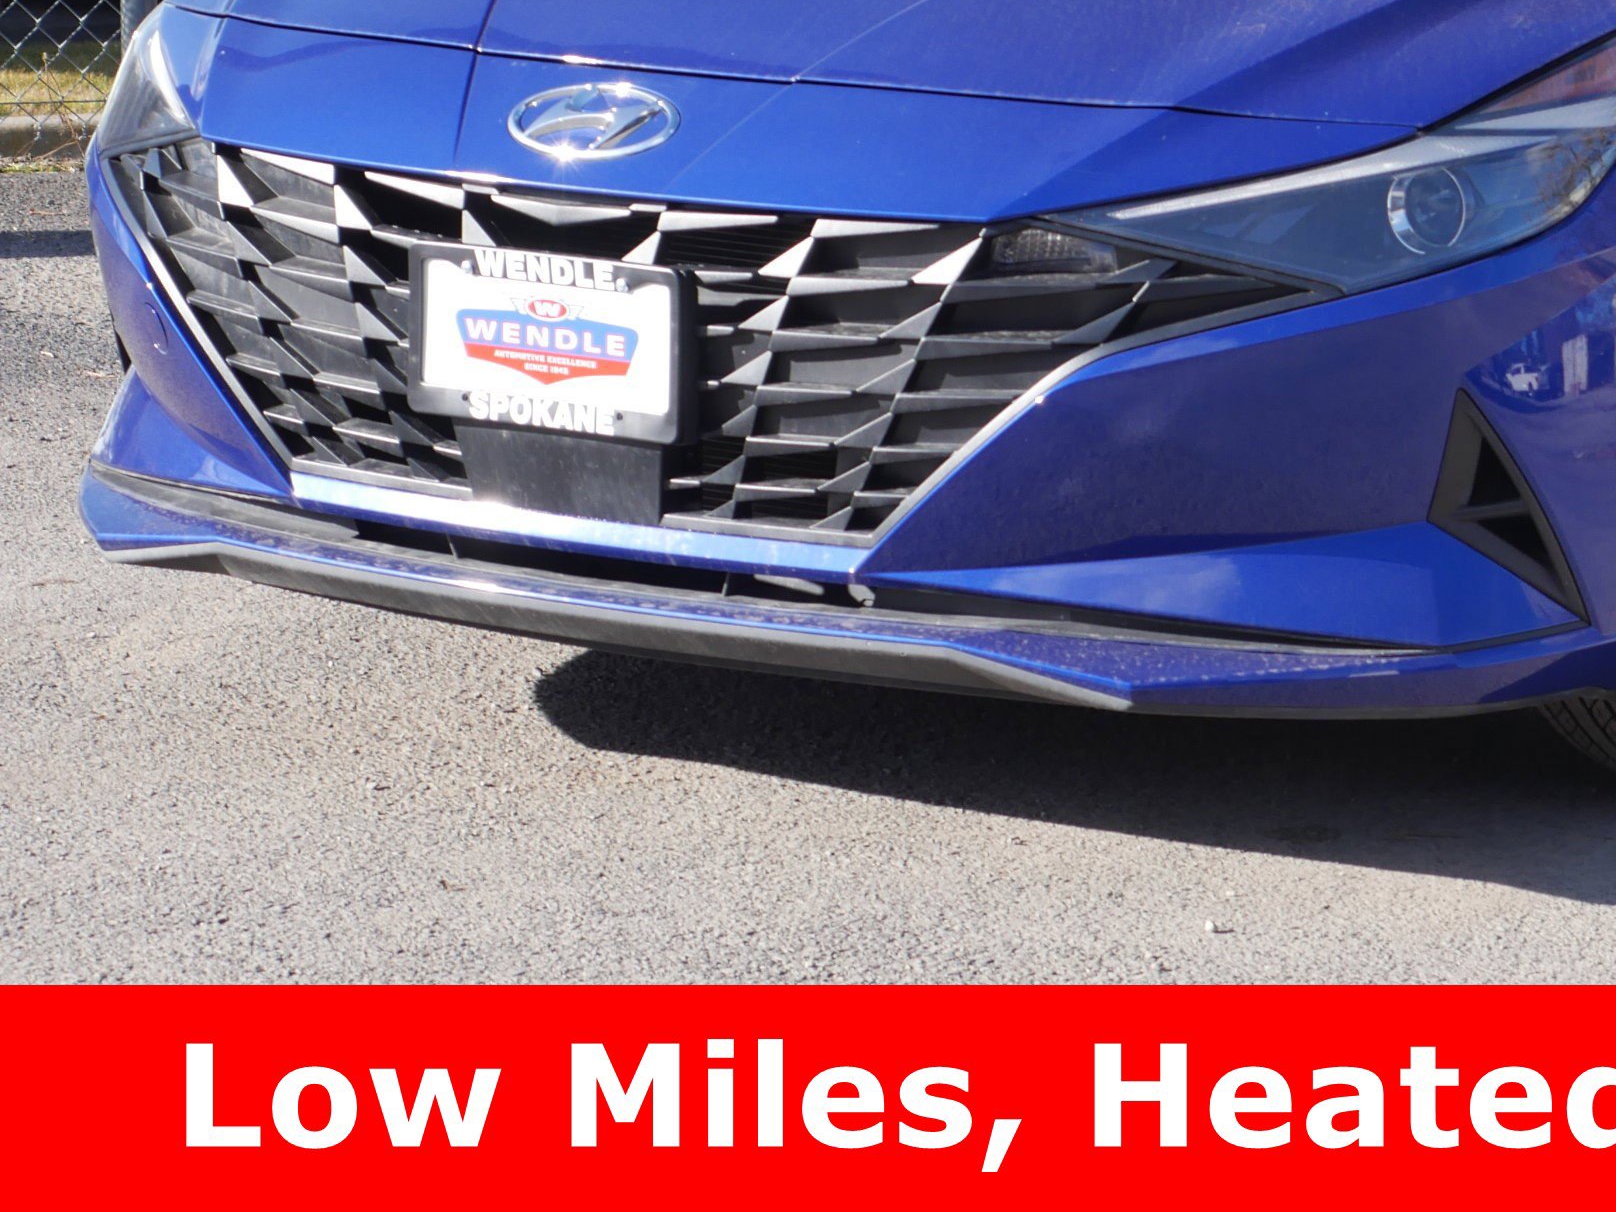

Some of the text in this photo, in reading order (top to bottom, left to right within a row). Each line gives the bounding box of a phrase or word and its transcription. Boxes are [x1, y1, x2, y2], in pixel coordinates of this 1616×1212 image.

[474, 248, 615, 291] WENDLE
[533, 300, 561, 317] W
[464, 317, 625, 357] WENDLE
[494, 349, 597, 369] AUTOMOTIVE EXCELLENCE
[468, 388, 615, 436] SPOKANE
